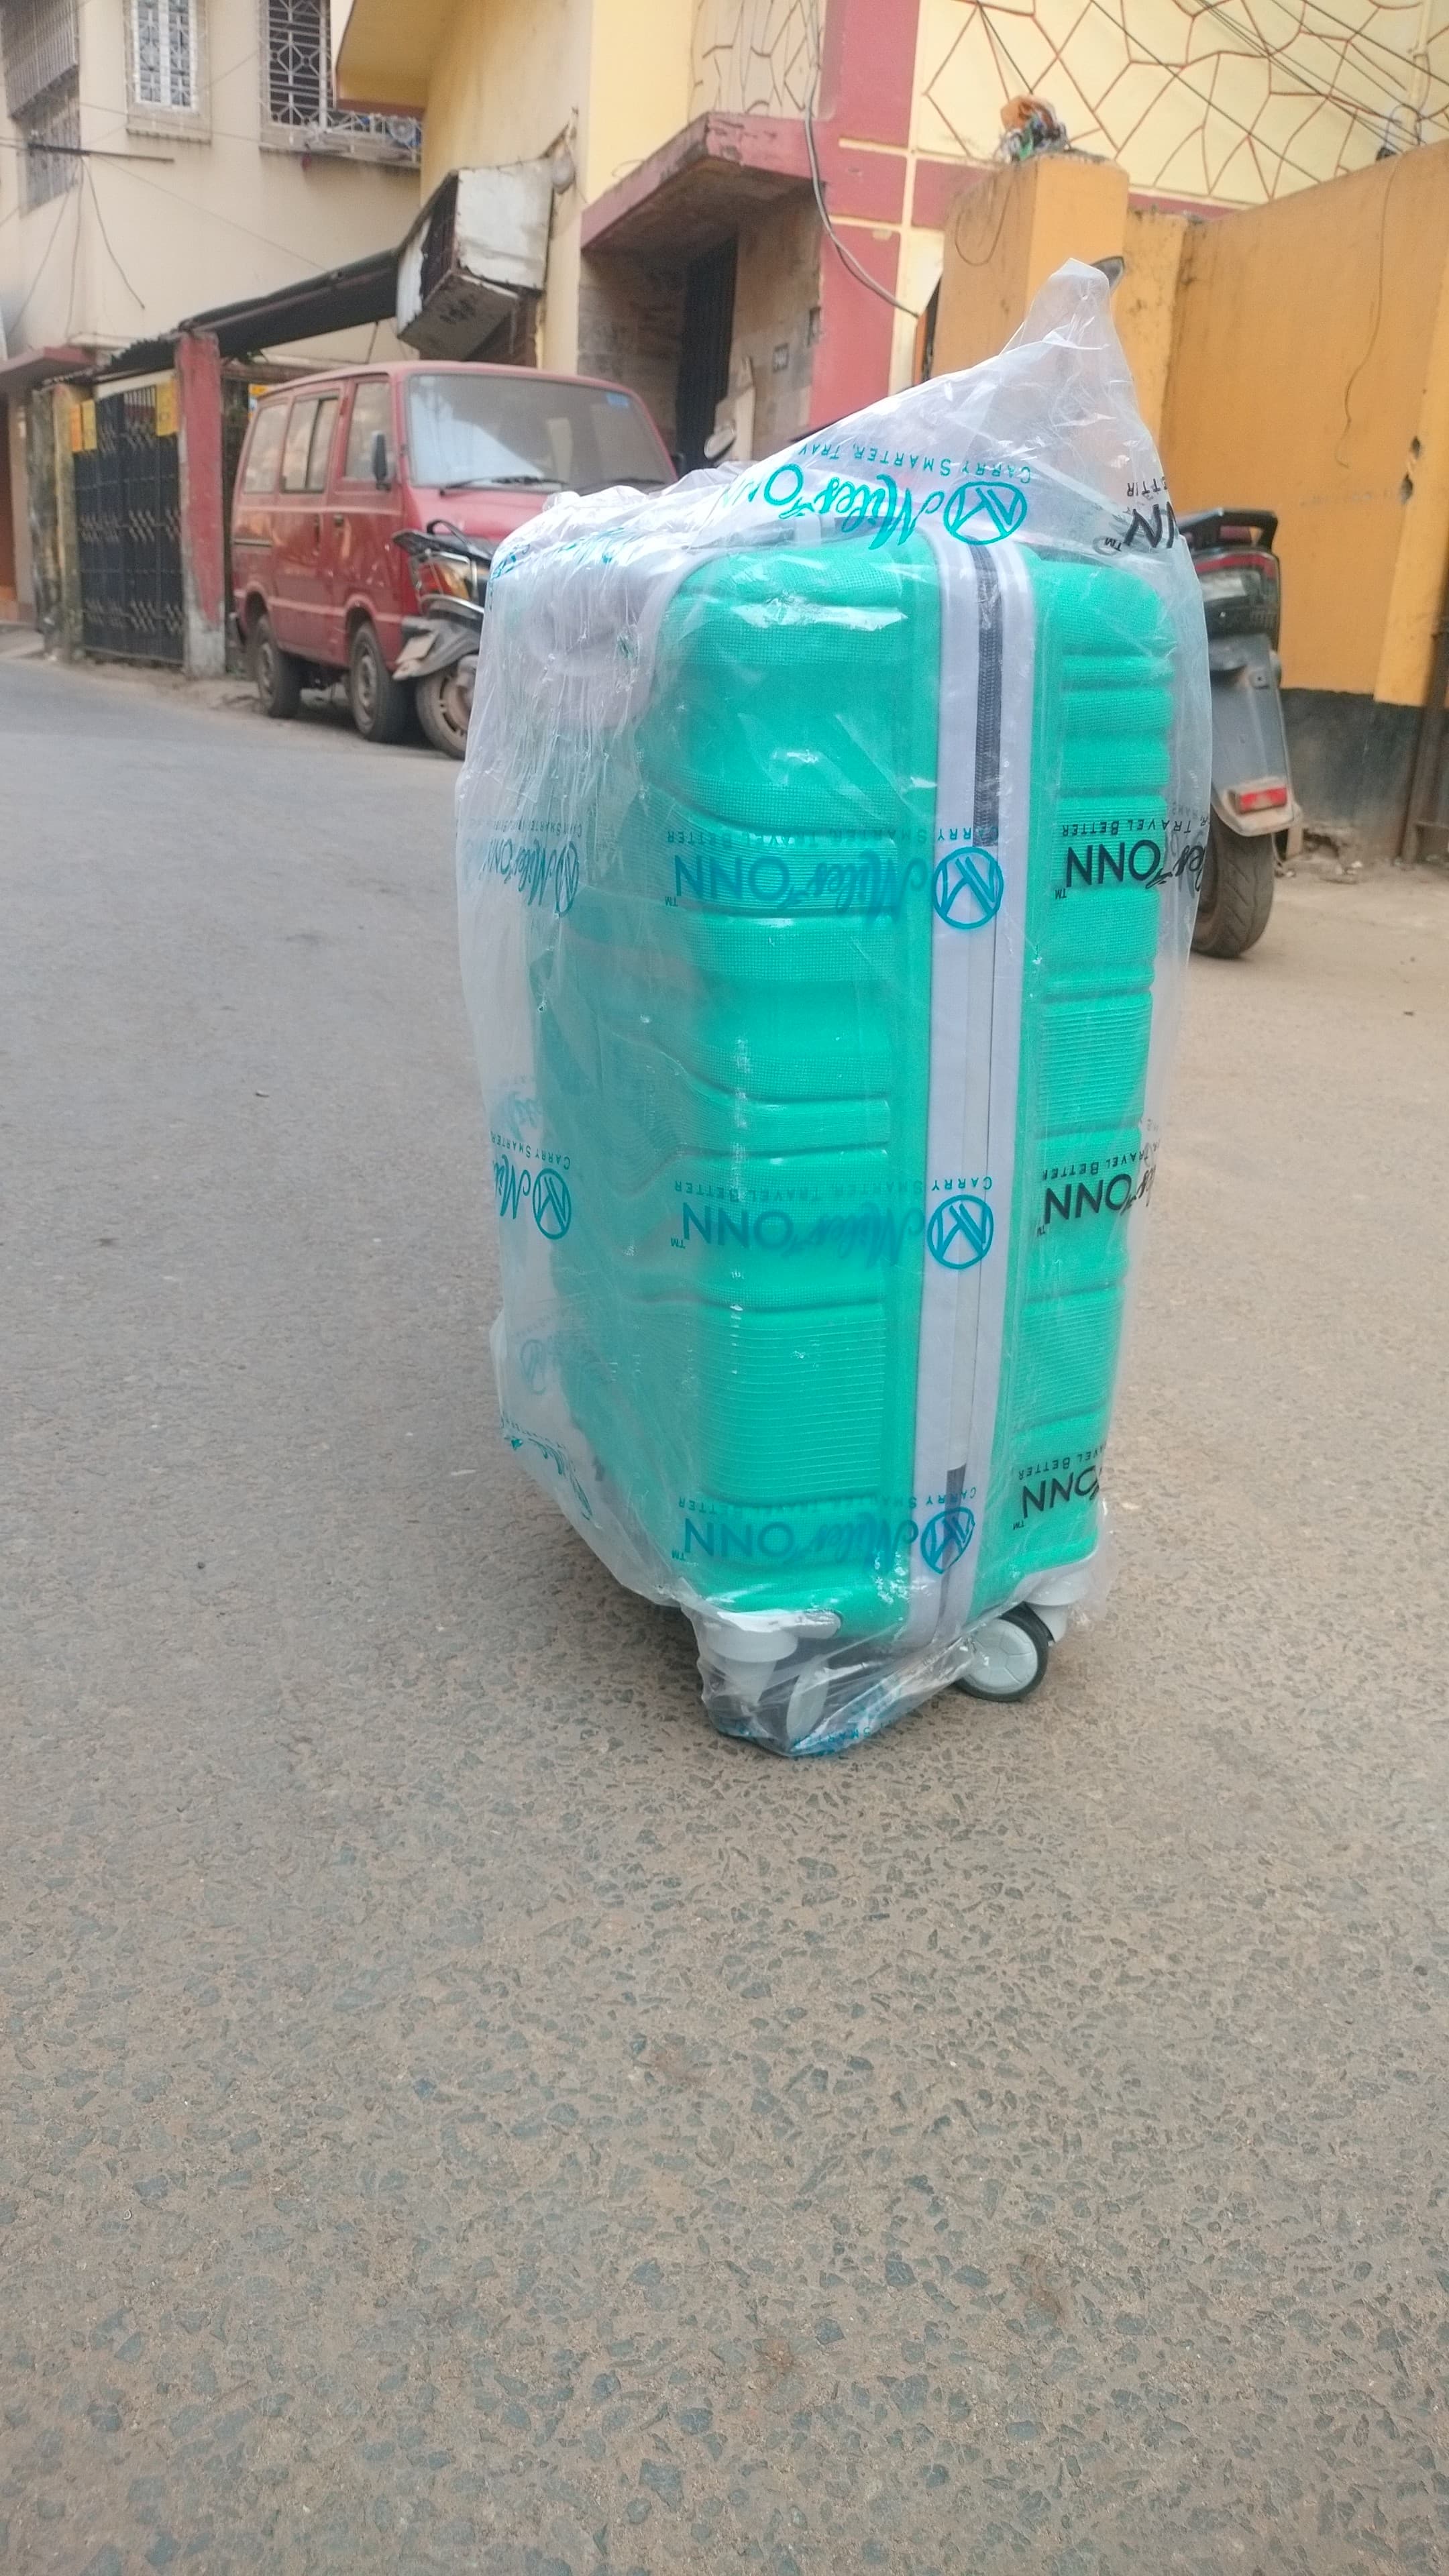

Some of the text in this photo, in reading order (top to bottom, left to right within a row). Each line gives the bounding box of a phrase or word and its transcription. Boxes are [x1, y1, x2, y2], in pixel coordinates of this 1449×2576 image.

[798, 443, 1031, 484] CARRY SMARTER, TRAV
[813, 474, 945, 550] Miles
[1062, 820, 1120, 837] BETTER
[1128, 818, 1191, 834] TRAVEL
[674, 854, 790, 901] ONN
[1066, 839, 1161, 888] ONN
[806, 849, 928, 928] Miles
[535, 1148, 571, 1171] CARRY
[674, 1179, 739, 1203] BETTER
[932, 1176, 994, 1191] CARRY
[1044, 1173, 1132, 1224] ONN
[682, 1202, 794, 1249] ONN
[807, 1201, 926, 1270] Miles
[1018, 1456, 1071, 1481] BETTER
[926, 1486, 977, 1505] CARRY
[1022, 1465, 1099, 1519] ONN
[684, 1517, 795, 1557] ONN
[810, 1511, 919, 1576] Miles
